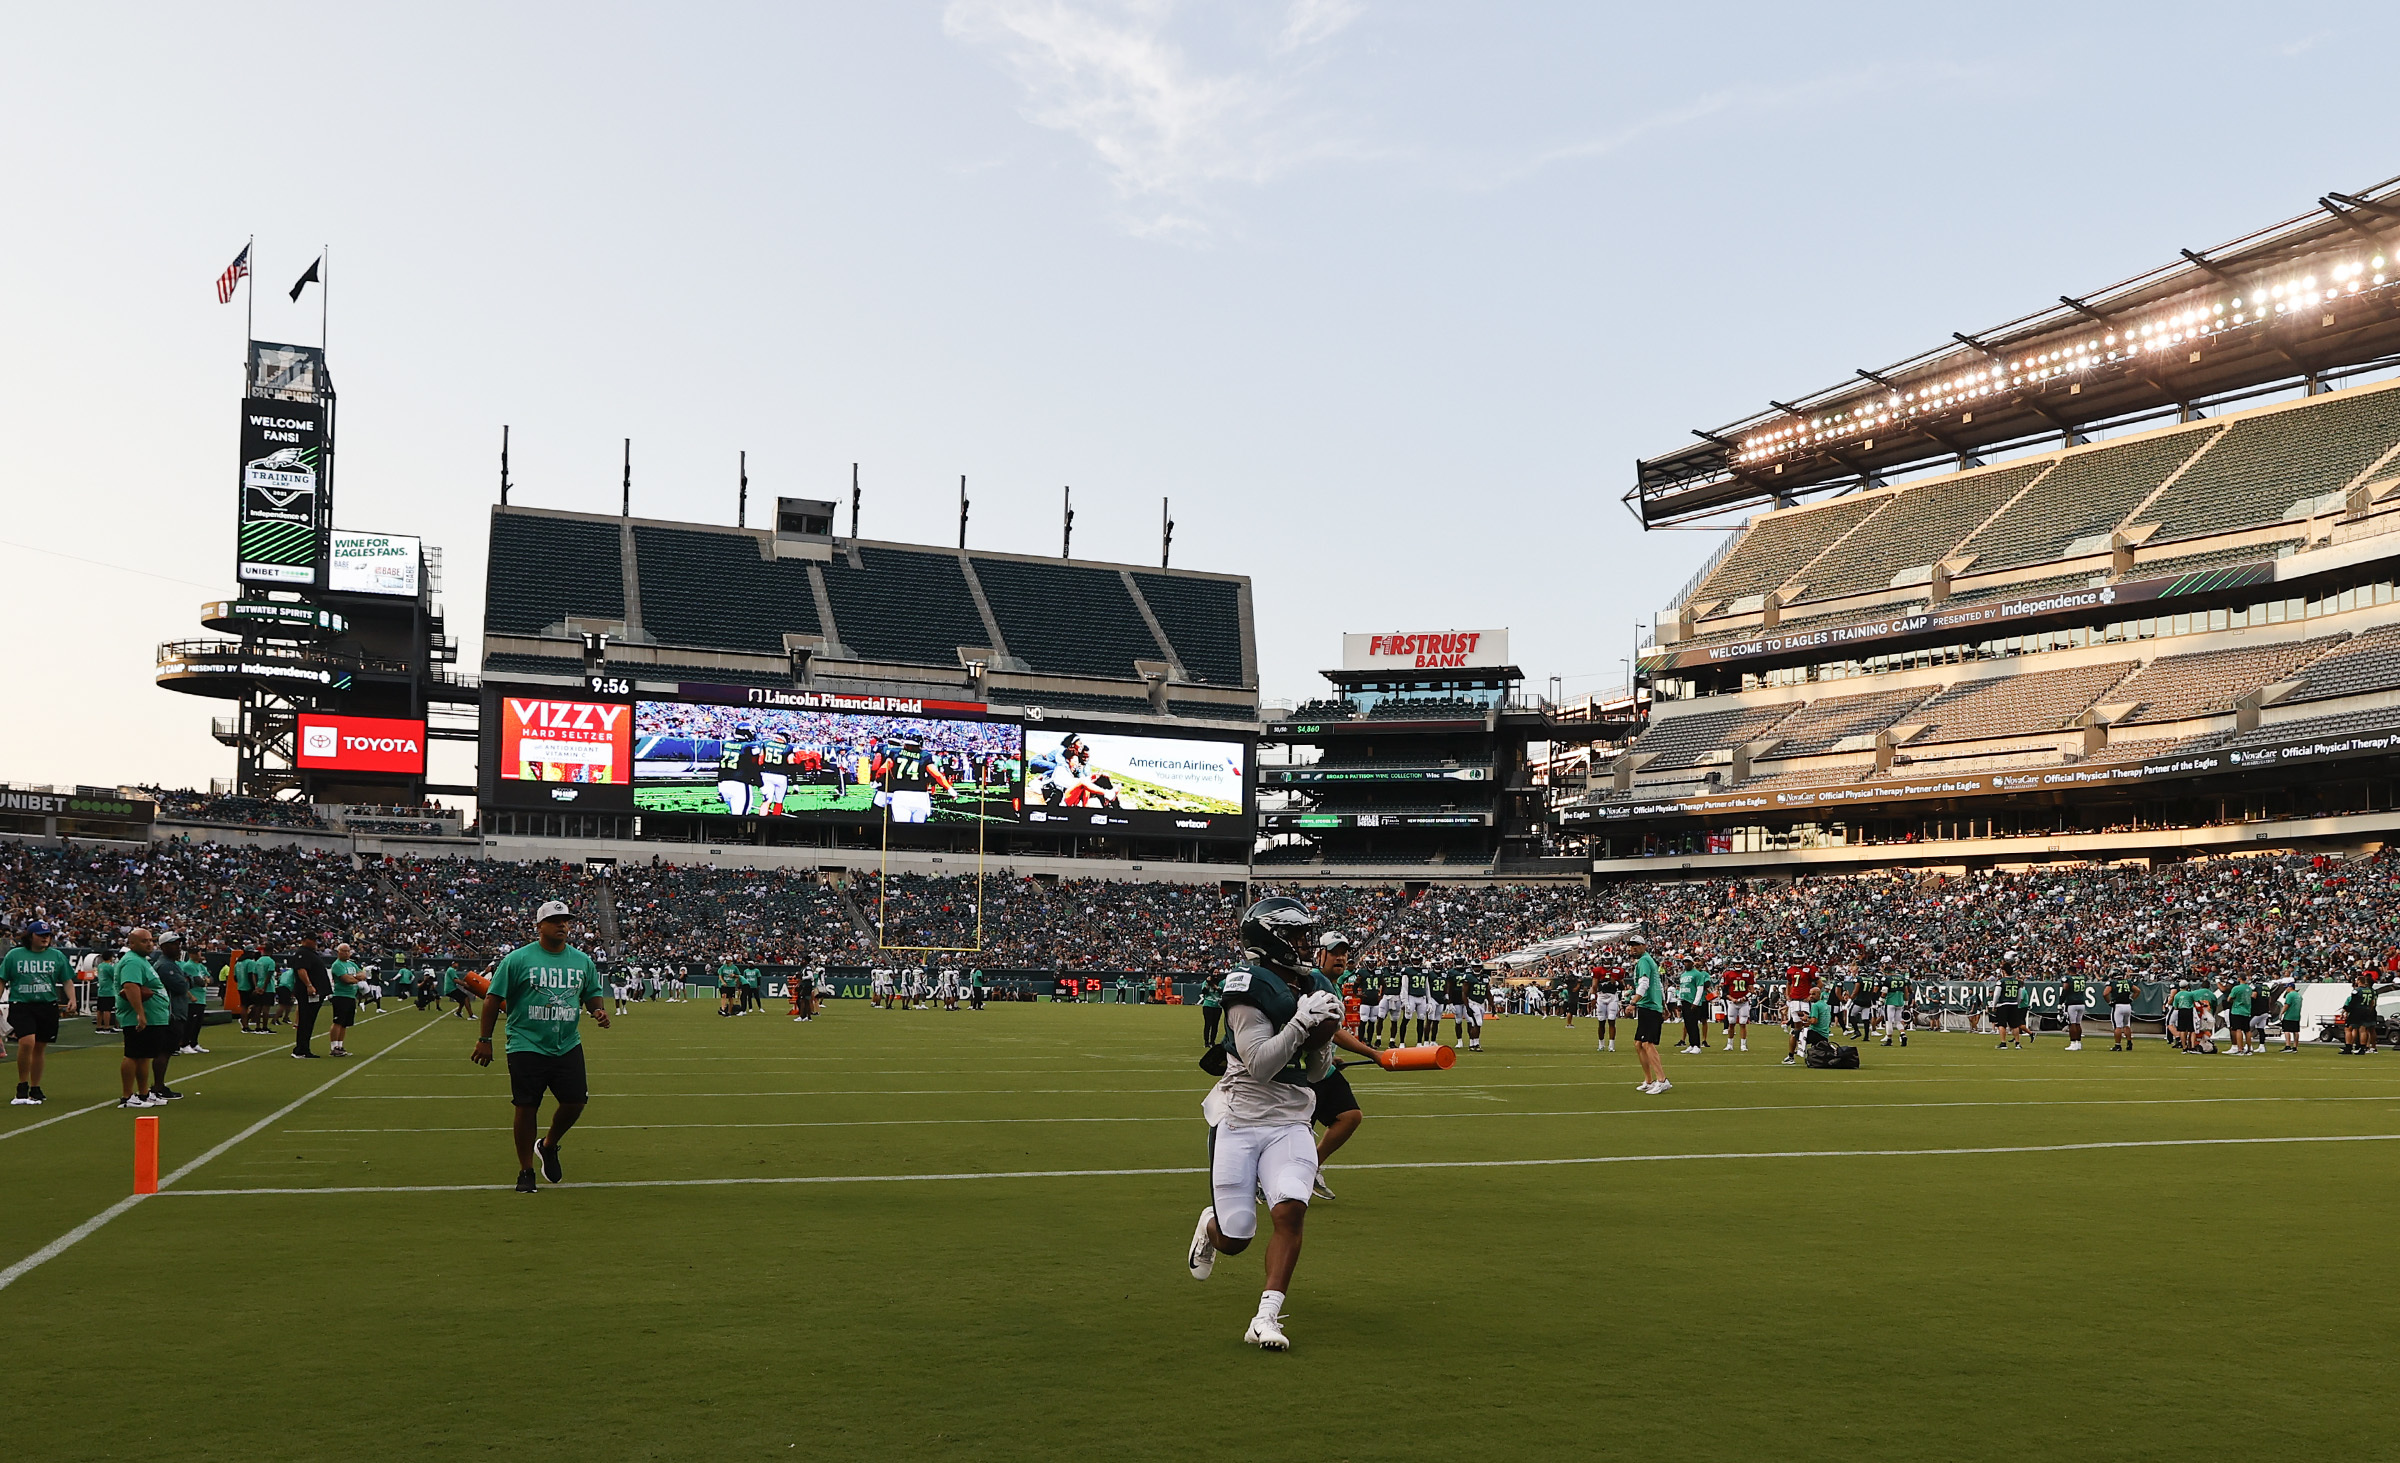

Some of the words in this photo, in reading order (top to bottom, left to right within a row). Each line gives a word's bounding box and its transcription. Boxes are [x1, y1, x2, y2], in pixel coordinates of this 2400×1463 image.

[249, 415, 314, 431] WELCOME
[263, 430, 300, 443] FANS!
[252, 471, 309, 484] TRAINING
[250, 510, 299, 520] Independence
[335, 539, 365, 548] WINE
[366, 538, 389, 547] FOR
[335, 548, 375, 558] EAGLES
[377, 547, 408, 557] FANS.
[245, 567, 279, 577] UNIBET
[235, 605, 278, 615] CUTWATER
[279, 607, 312, 619] SPIRITS
[1709, 640, 1763, 660] WELCOME
[1766, 638, 1781, 651] TO
[1784, 631, 1828, 649] EAGLES
[1831, 622, 1888, 642] TRAINING
[1891, 616, 1928, 633] CAMP
[1932, 611, 1982, 627] PRESENTED
[1984, 609, 1996, 620] BY
[2001, 590, 2097, 617] Independence
[1415, 653, 1468, 668] BANK
[187, 664, 226, 673] PRESENTED
[227, 664, 238, 673] BY
[241, 662, 319, 680] Independence
[591, 677, 630, 695] 9:56
[764, 689, 819, 707] Lincoln
[820, 692, 886, 711] Financial
[886, 697, 922, 714] Field
[510, 699, 622, 731] VIZZY
[522, 728, 556, 738] HARD
[561, 730, 613, 741] SELTZER
[1297, 725, 1320, 733] $4,860
[343, 736, 418, 753] TOYOTA
[544, 744, 599, 753] ANTIOXIDANT
[2241, 748, 2277, 762] NovaCare
[2281, 745, 2313, 758] Official
[2314, 740, 2350, 755] Physical
[2350, 738, 2389, 750] Therapy
[764, 746, 784, 765] 65
[896, 757, 920, 781] 74
[1129, 757, 1182, 769] American
[1183, 759, 1224, 772] Airlines
[1155, 771, 1169, 780] You
[1170, 773, 1184, 781] are
[1185, 773, 1201, 782] why
[2003, 774, 2040, 786] NovaCare
[2043, 773, 2075, 784] Official
[2076, 770, 2110, 783] Physical
[2112, 767, 2143, 779] Therapy
[2143, 765, 2170, 775] Partner
[2171, 762, 2180, 771] of
[2180, 761, 2193, 770] the
[2194, 757, 2218, 770] Eagles
[1786, 792, 1815, 802] NovaCare
[1818, 790, 1845, 801] Official
[1845, 788, 1874, 800] Physical
[1874, 787, 1904, 797] Therapy
[1904, 785, 1933, 794] Partner
[1933, 784, 1942, 792] of
[1942, 782, 1955, 791] the
[1956, 780, 1981, 792] Eagles
[1606, 806, 1631, 815] NovaCare
[1633, 805, 1655, 815] Official
[1655, 803, 1679, 814] Physical
[1680, 802, 1704, 812] Therapy
[1704, 800, 1727, 809] Partner
[1735, 798, 1746, 807] the
[1746, 797, 1767, 807] Eagles
[1573, 811, 1590, 820] Eagles
[1175, 818, 1208, 829] verizon
[17, 960, 56, 974] EAGLES
[529, 966, 584, 989] EAGLES
[1365, 977, 1379, 990] 14
[1412, 975, 1425, 989] 34
[1793, 974, 1801, 987] 7
[1086, 979, 1100, 991] 25
[1432, 979, 1446, 992] 32
[1472, 983, 1487, 996] 35
[1733, 979, 1746, 992] 10
[2004, 985, 2018, 998] 56
